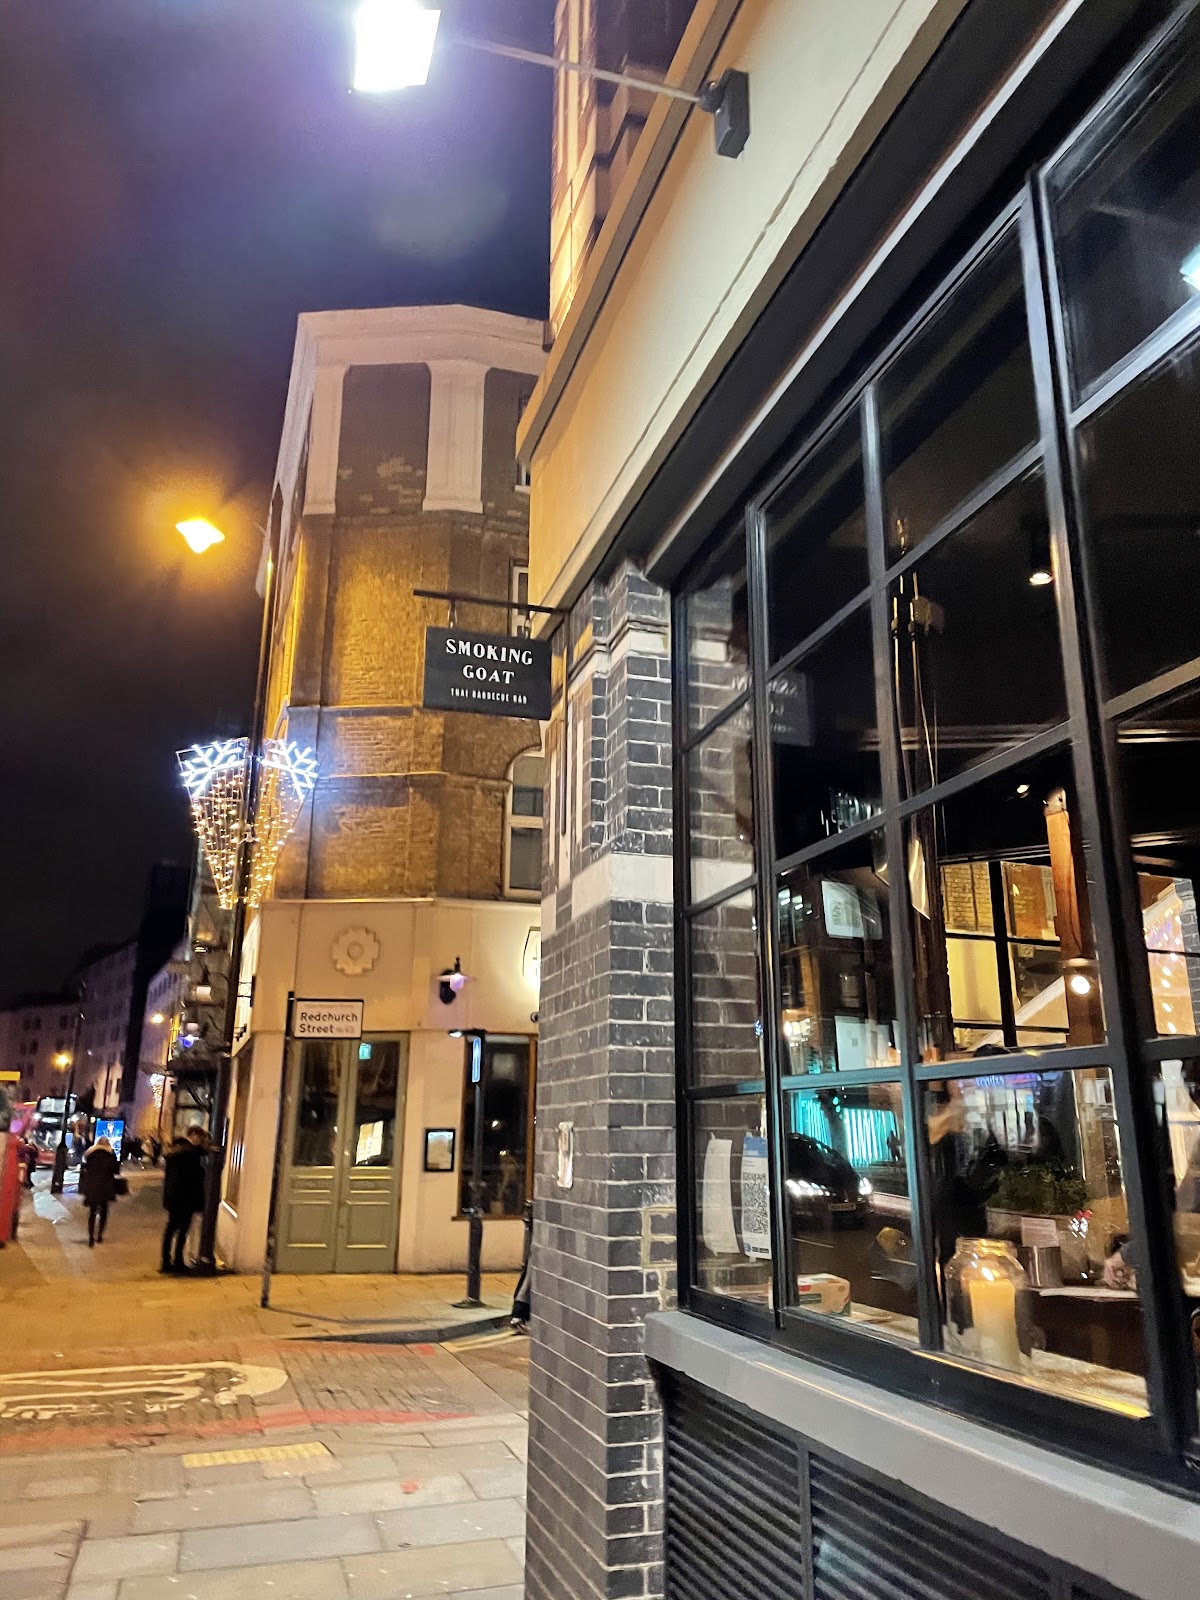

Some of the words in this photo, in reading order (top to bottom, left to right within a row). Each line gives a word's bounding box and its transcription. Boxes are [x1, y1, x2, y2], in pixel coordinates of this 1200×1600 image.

[445, 638, 533, 665] SMOKING
[462, 664, 515, 684] GOAT
[451, 687, 468, 697] THAI
[301, 1012, 358, 1021] Redchurch
[299, 1023, 334, 1033] Street
